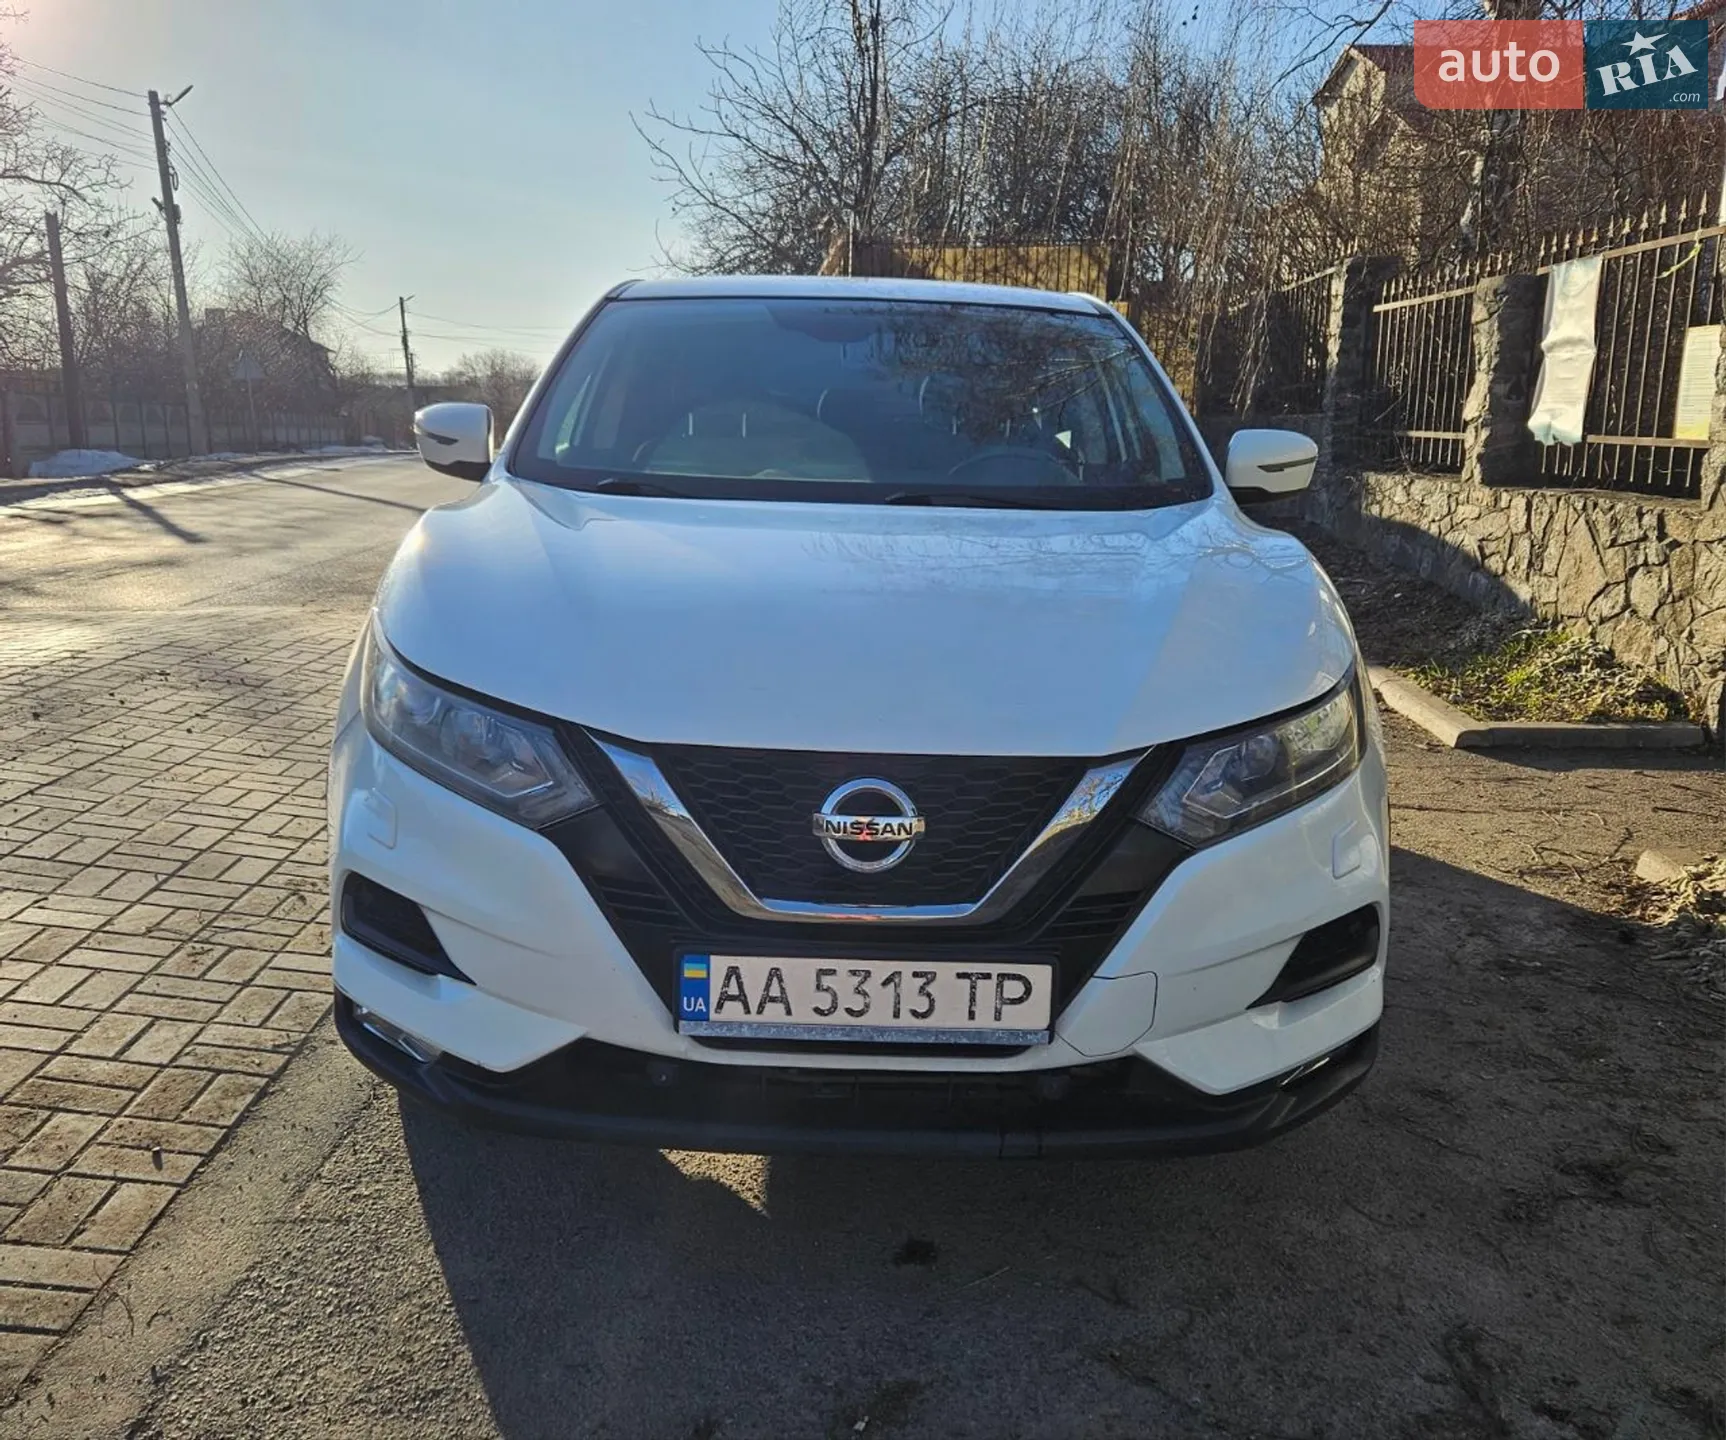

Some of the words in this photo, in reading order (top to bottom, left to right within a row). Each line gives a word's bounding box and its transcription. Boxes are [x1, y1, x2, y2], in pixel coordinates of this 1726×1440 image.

[825, 819, 913, 836] NISSAN
[713, 965, 793, 1017] AA
[811, 967, 938, 1021] 5313
[955, 971, 1033, 1021] TP
[683, 996, 706, 1013] UA
